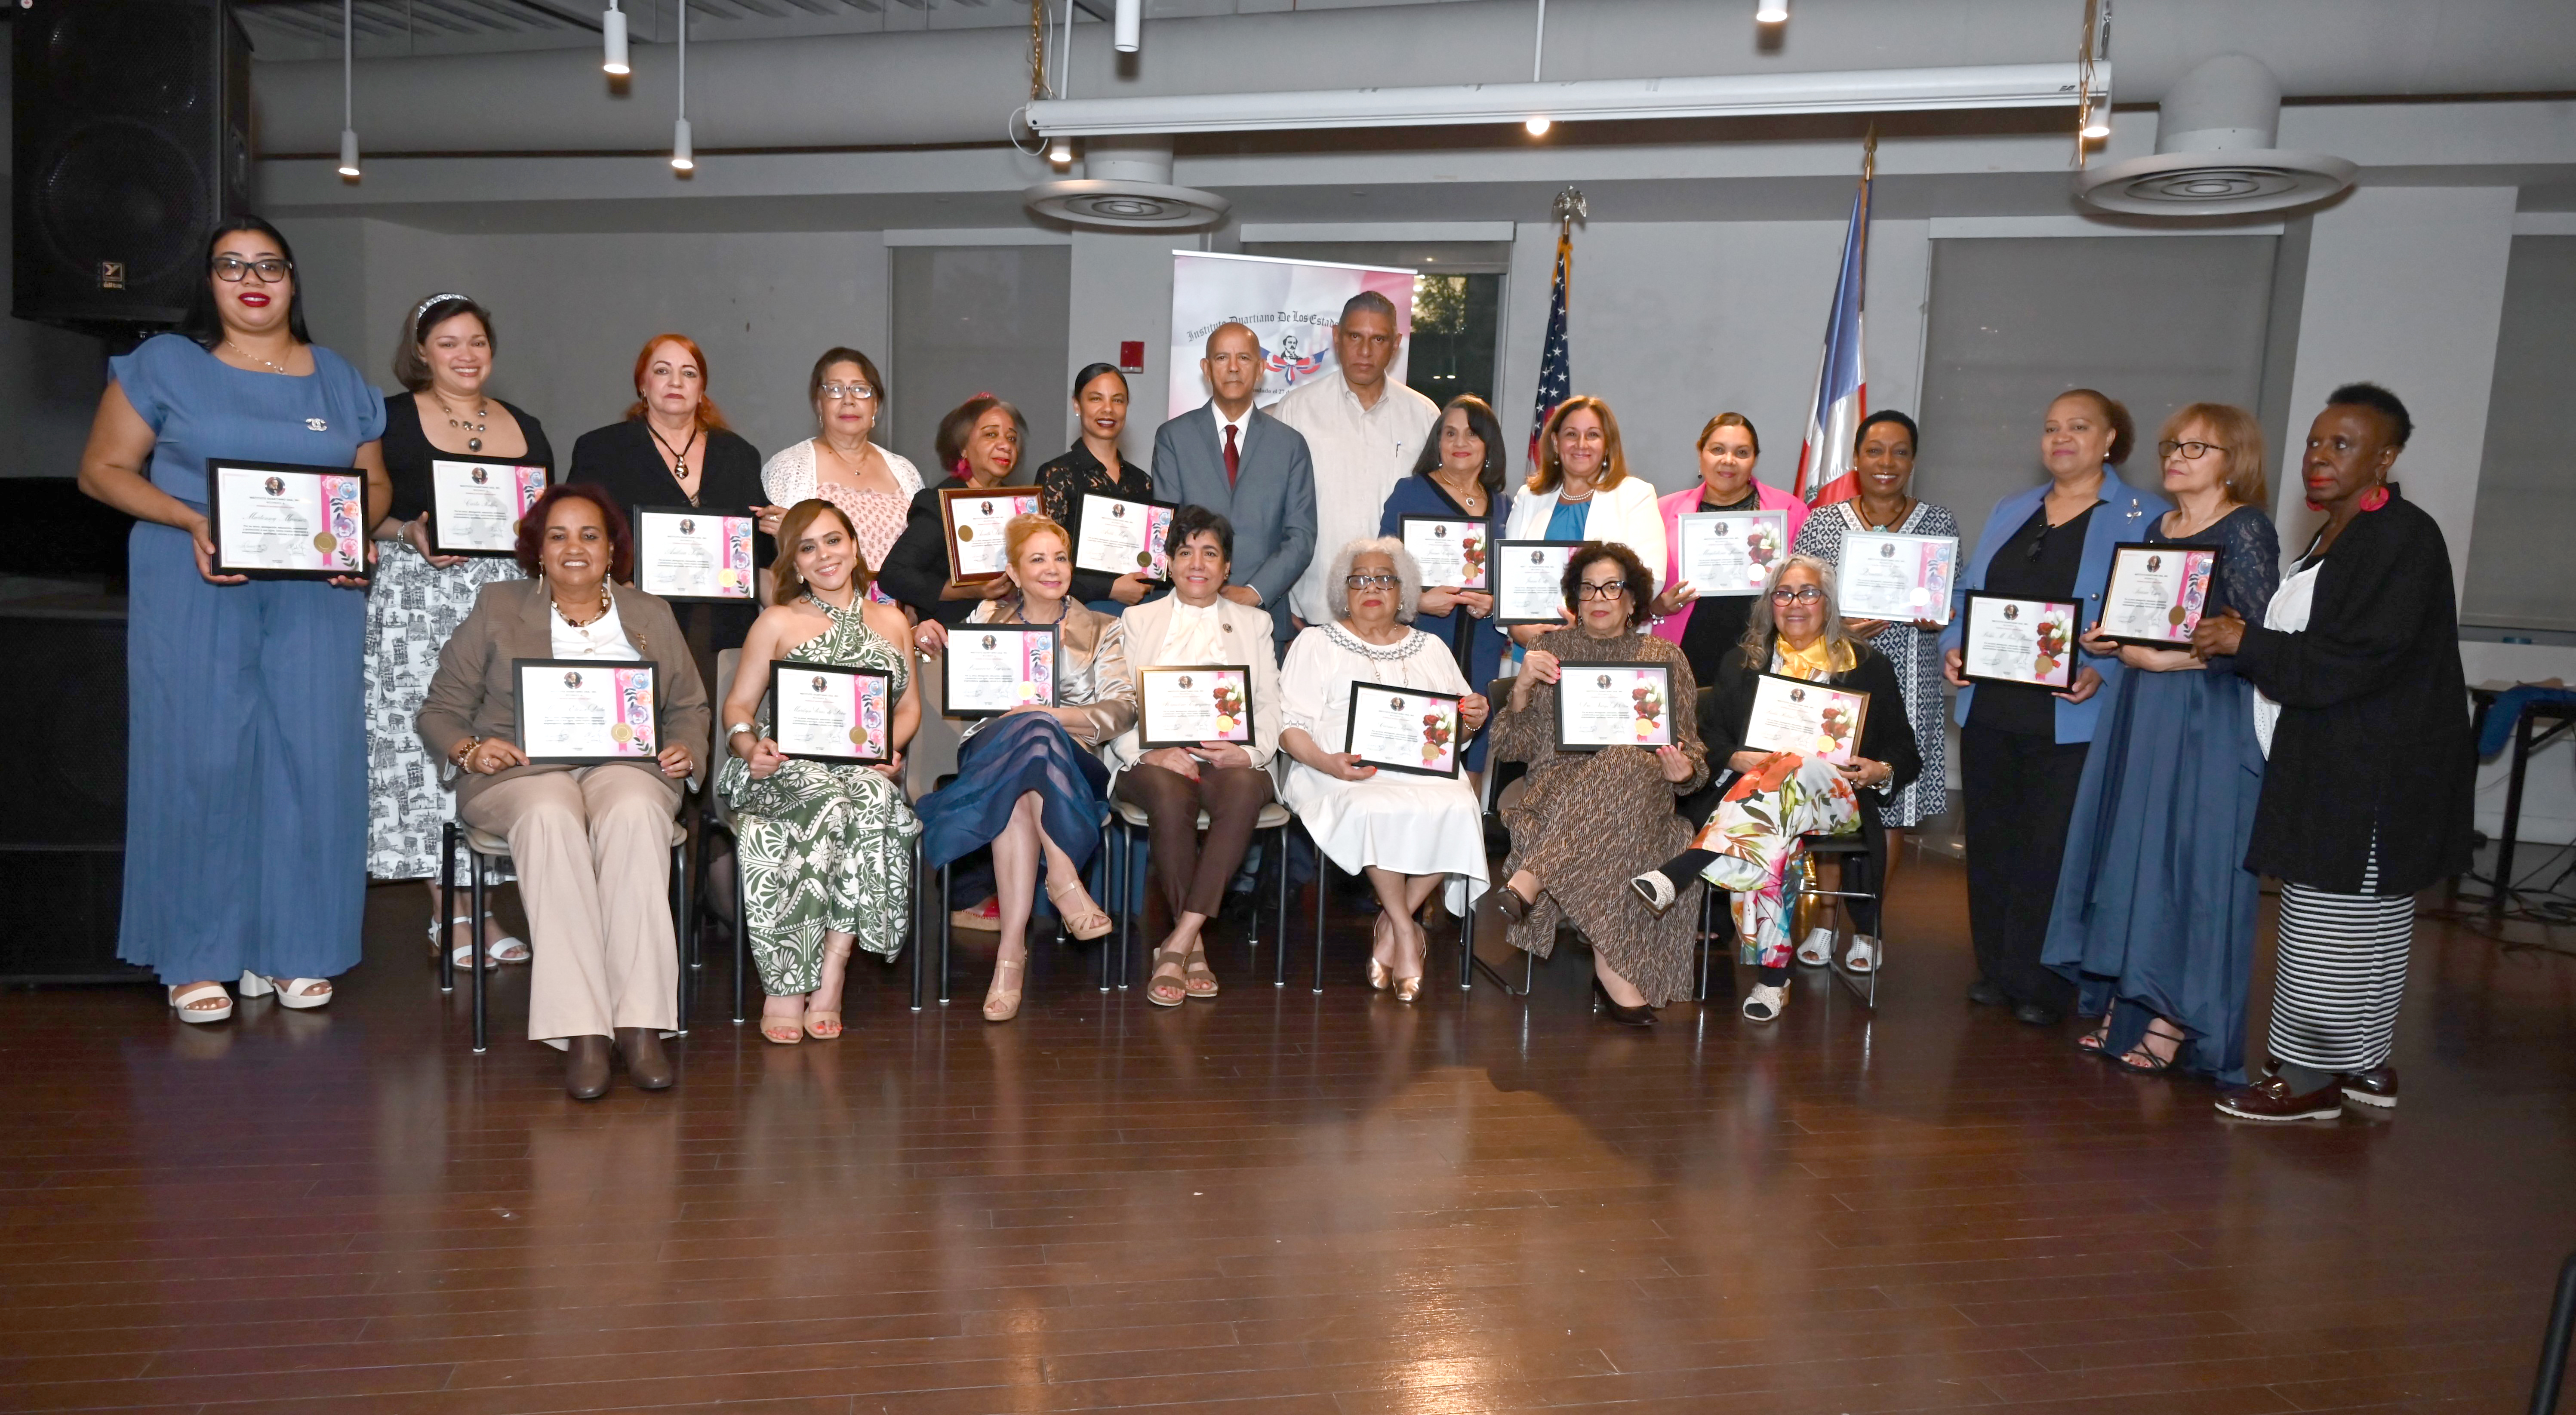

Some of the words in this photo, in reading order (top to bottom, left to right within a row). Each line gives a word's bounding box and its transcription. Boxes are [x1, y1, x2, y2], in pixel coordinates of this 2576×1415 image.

[1228, 313, 1274, 326] Duartiano
[1277, 311, 1291, 322] De
[1293, 311, 1308, 322] Los
[1309, 314, 1339, 328] Estado
